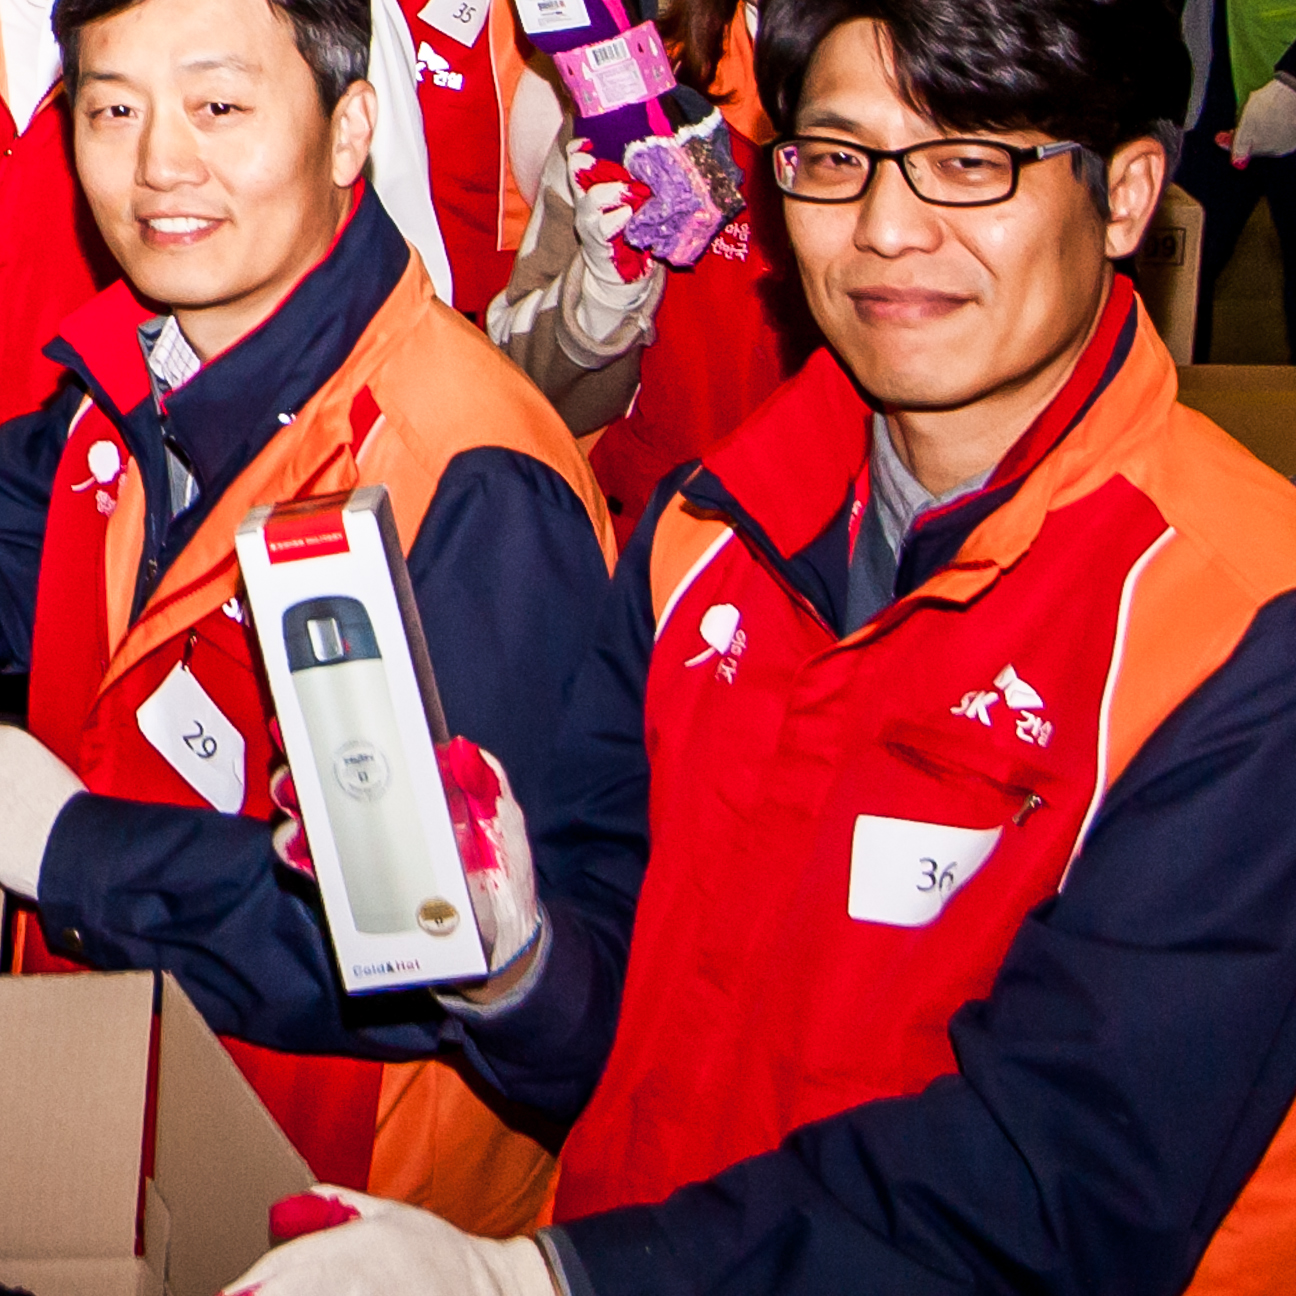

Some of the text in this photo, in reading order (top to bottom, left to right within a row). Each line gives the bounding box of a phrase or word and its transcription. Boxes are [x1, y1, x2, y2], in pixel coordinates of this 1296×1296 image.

[452, 2, 477, 24] 35
[949, 690, 1000, 727] SK
[182, 718, 218, 760] 29
[916, 857, 959, 900] 36
